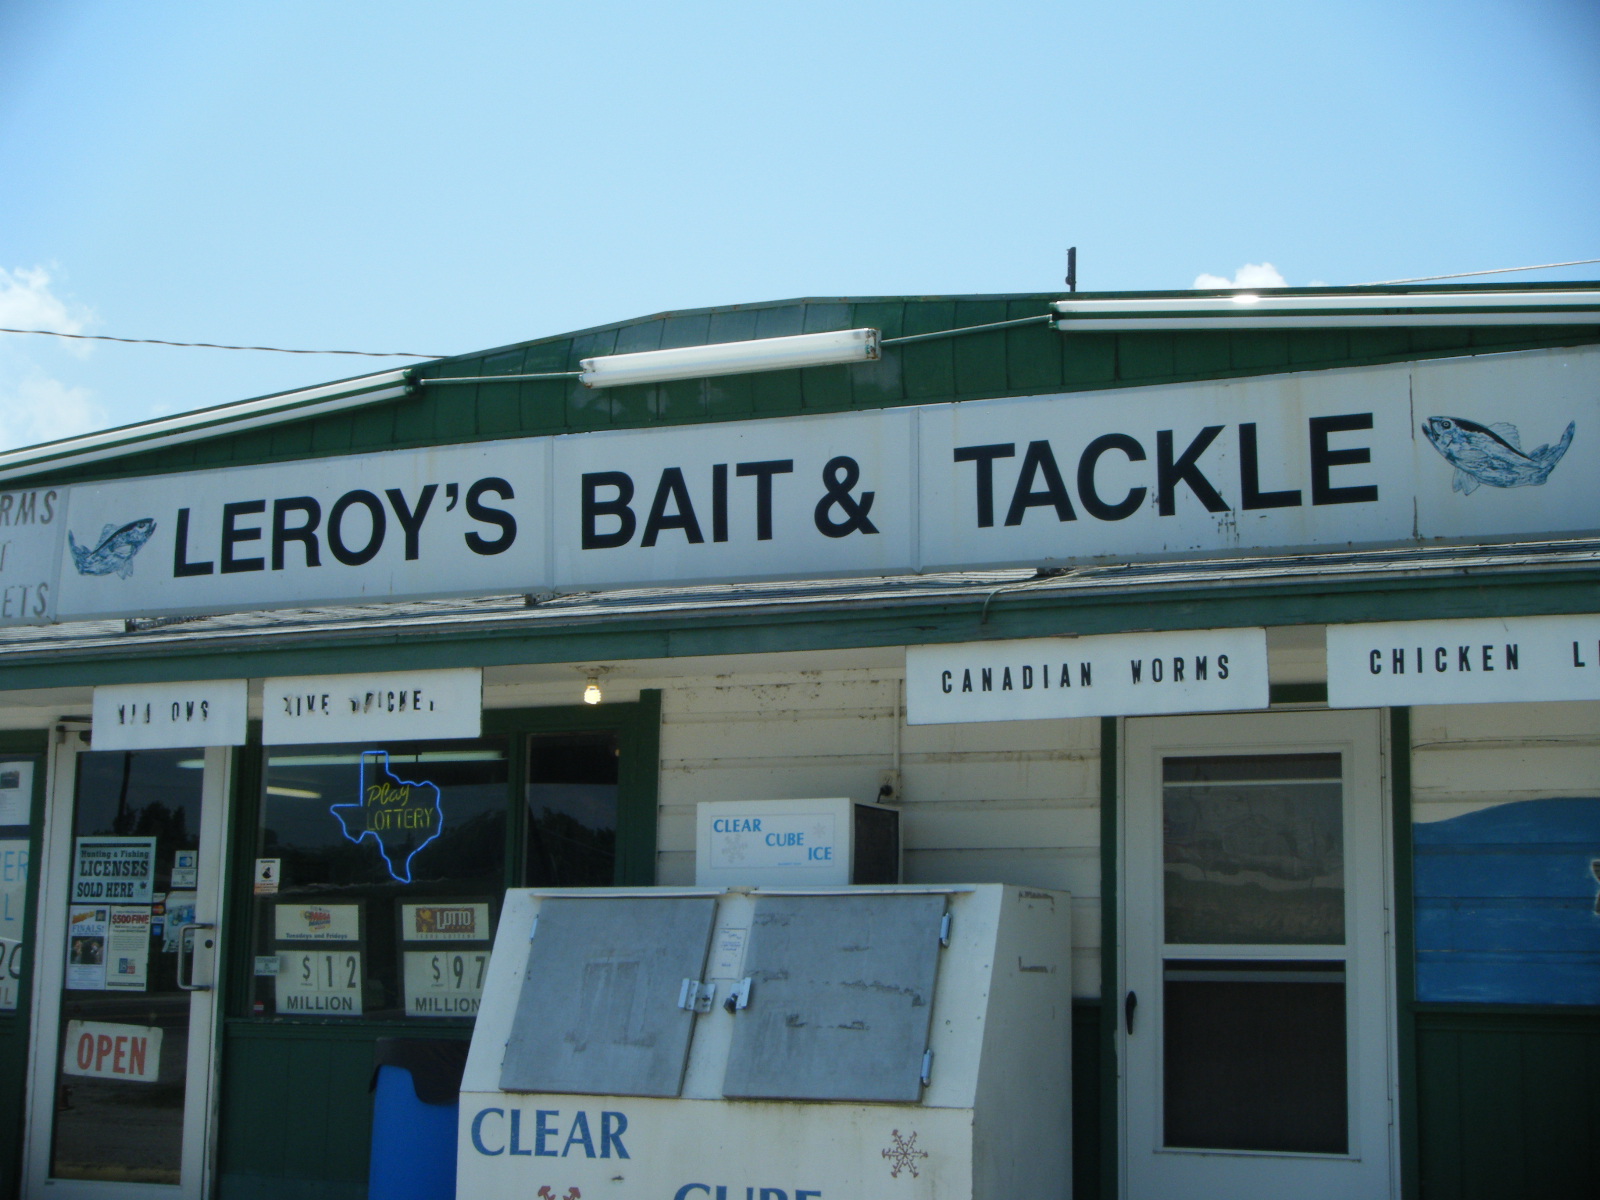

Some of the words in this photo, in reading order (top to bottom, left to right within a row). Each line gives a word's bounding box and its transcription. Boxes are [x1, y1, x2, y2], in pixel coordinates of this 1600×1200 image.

[173, 476, 517, 578] LEROY'S
[580, 459, 794, 551] BAIT
[813, 455, 880, 539] &
[953, 412, 1379, 528] TACKLE
[1368, 643, 1521, 675] CHICKEN
[940, 661, 1094, 695] CANADIAN
[1130, 654, 1232, 684] WORMS
[366, 782, 411, 807] Play
[366, 806, 434, 831] LOTTERY
[713, 818, 762, 833] CLEAR
[765, 832, 804, 847] CUBE
[80, 849, 112, 860] Hunting
[120, 849, 150, 860] Fishing
[807, 846, 832, 861] ICE
[79, 860, 149, 877] LICENSES
[77, 881, 104, 898] SOLD
[105, 881, 134, 898] HERE
[286, 995, 353, 1011] MILLION
[415, 997, 482, 1013] MILLION
[76, 1031, 148, 1076] OPEN
[470, 1106, 631, 1161] CLEAR
